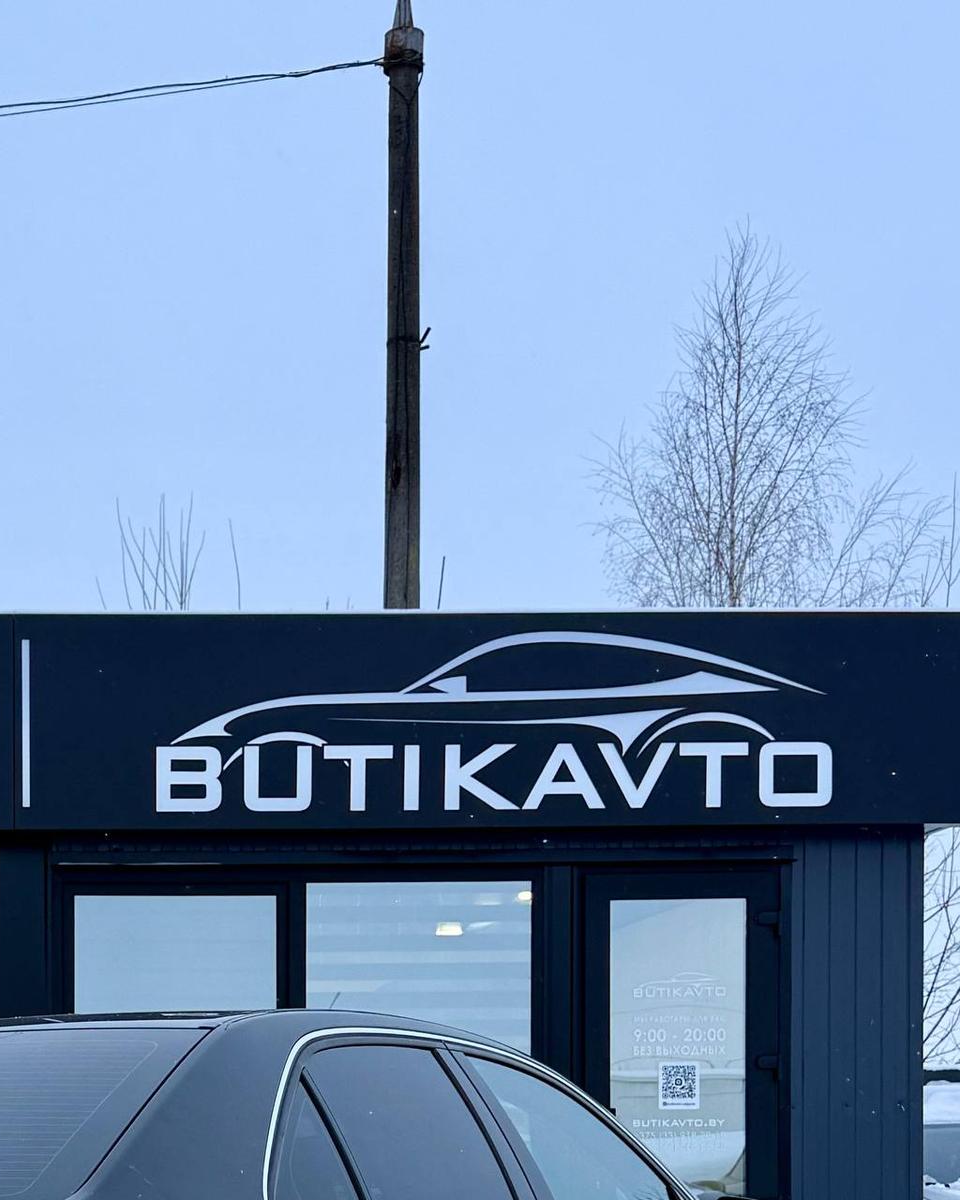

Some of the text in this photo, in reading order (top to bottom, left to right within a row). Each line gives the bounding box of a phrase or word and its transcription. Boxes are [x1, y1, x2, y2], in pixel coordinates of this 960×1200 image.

[156, 740, 833, 813] BUTIKAVTO
[633, 986, 726, 998] BUTIKAVTO
[634, 1029, 666, 1042] 9:00
[683, 1028, 726, 1042] 20:00
[633, 1045, 726, 1056] БЕЗ ВЫХОДНЫХ
[633, 1119, 726, 1128] BUTIKAVTO.BY
